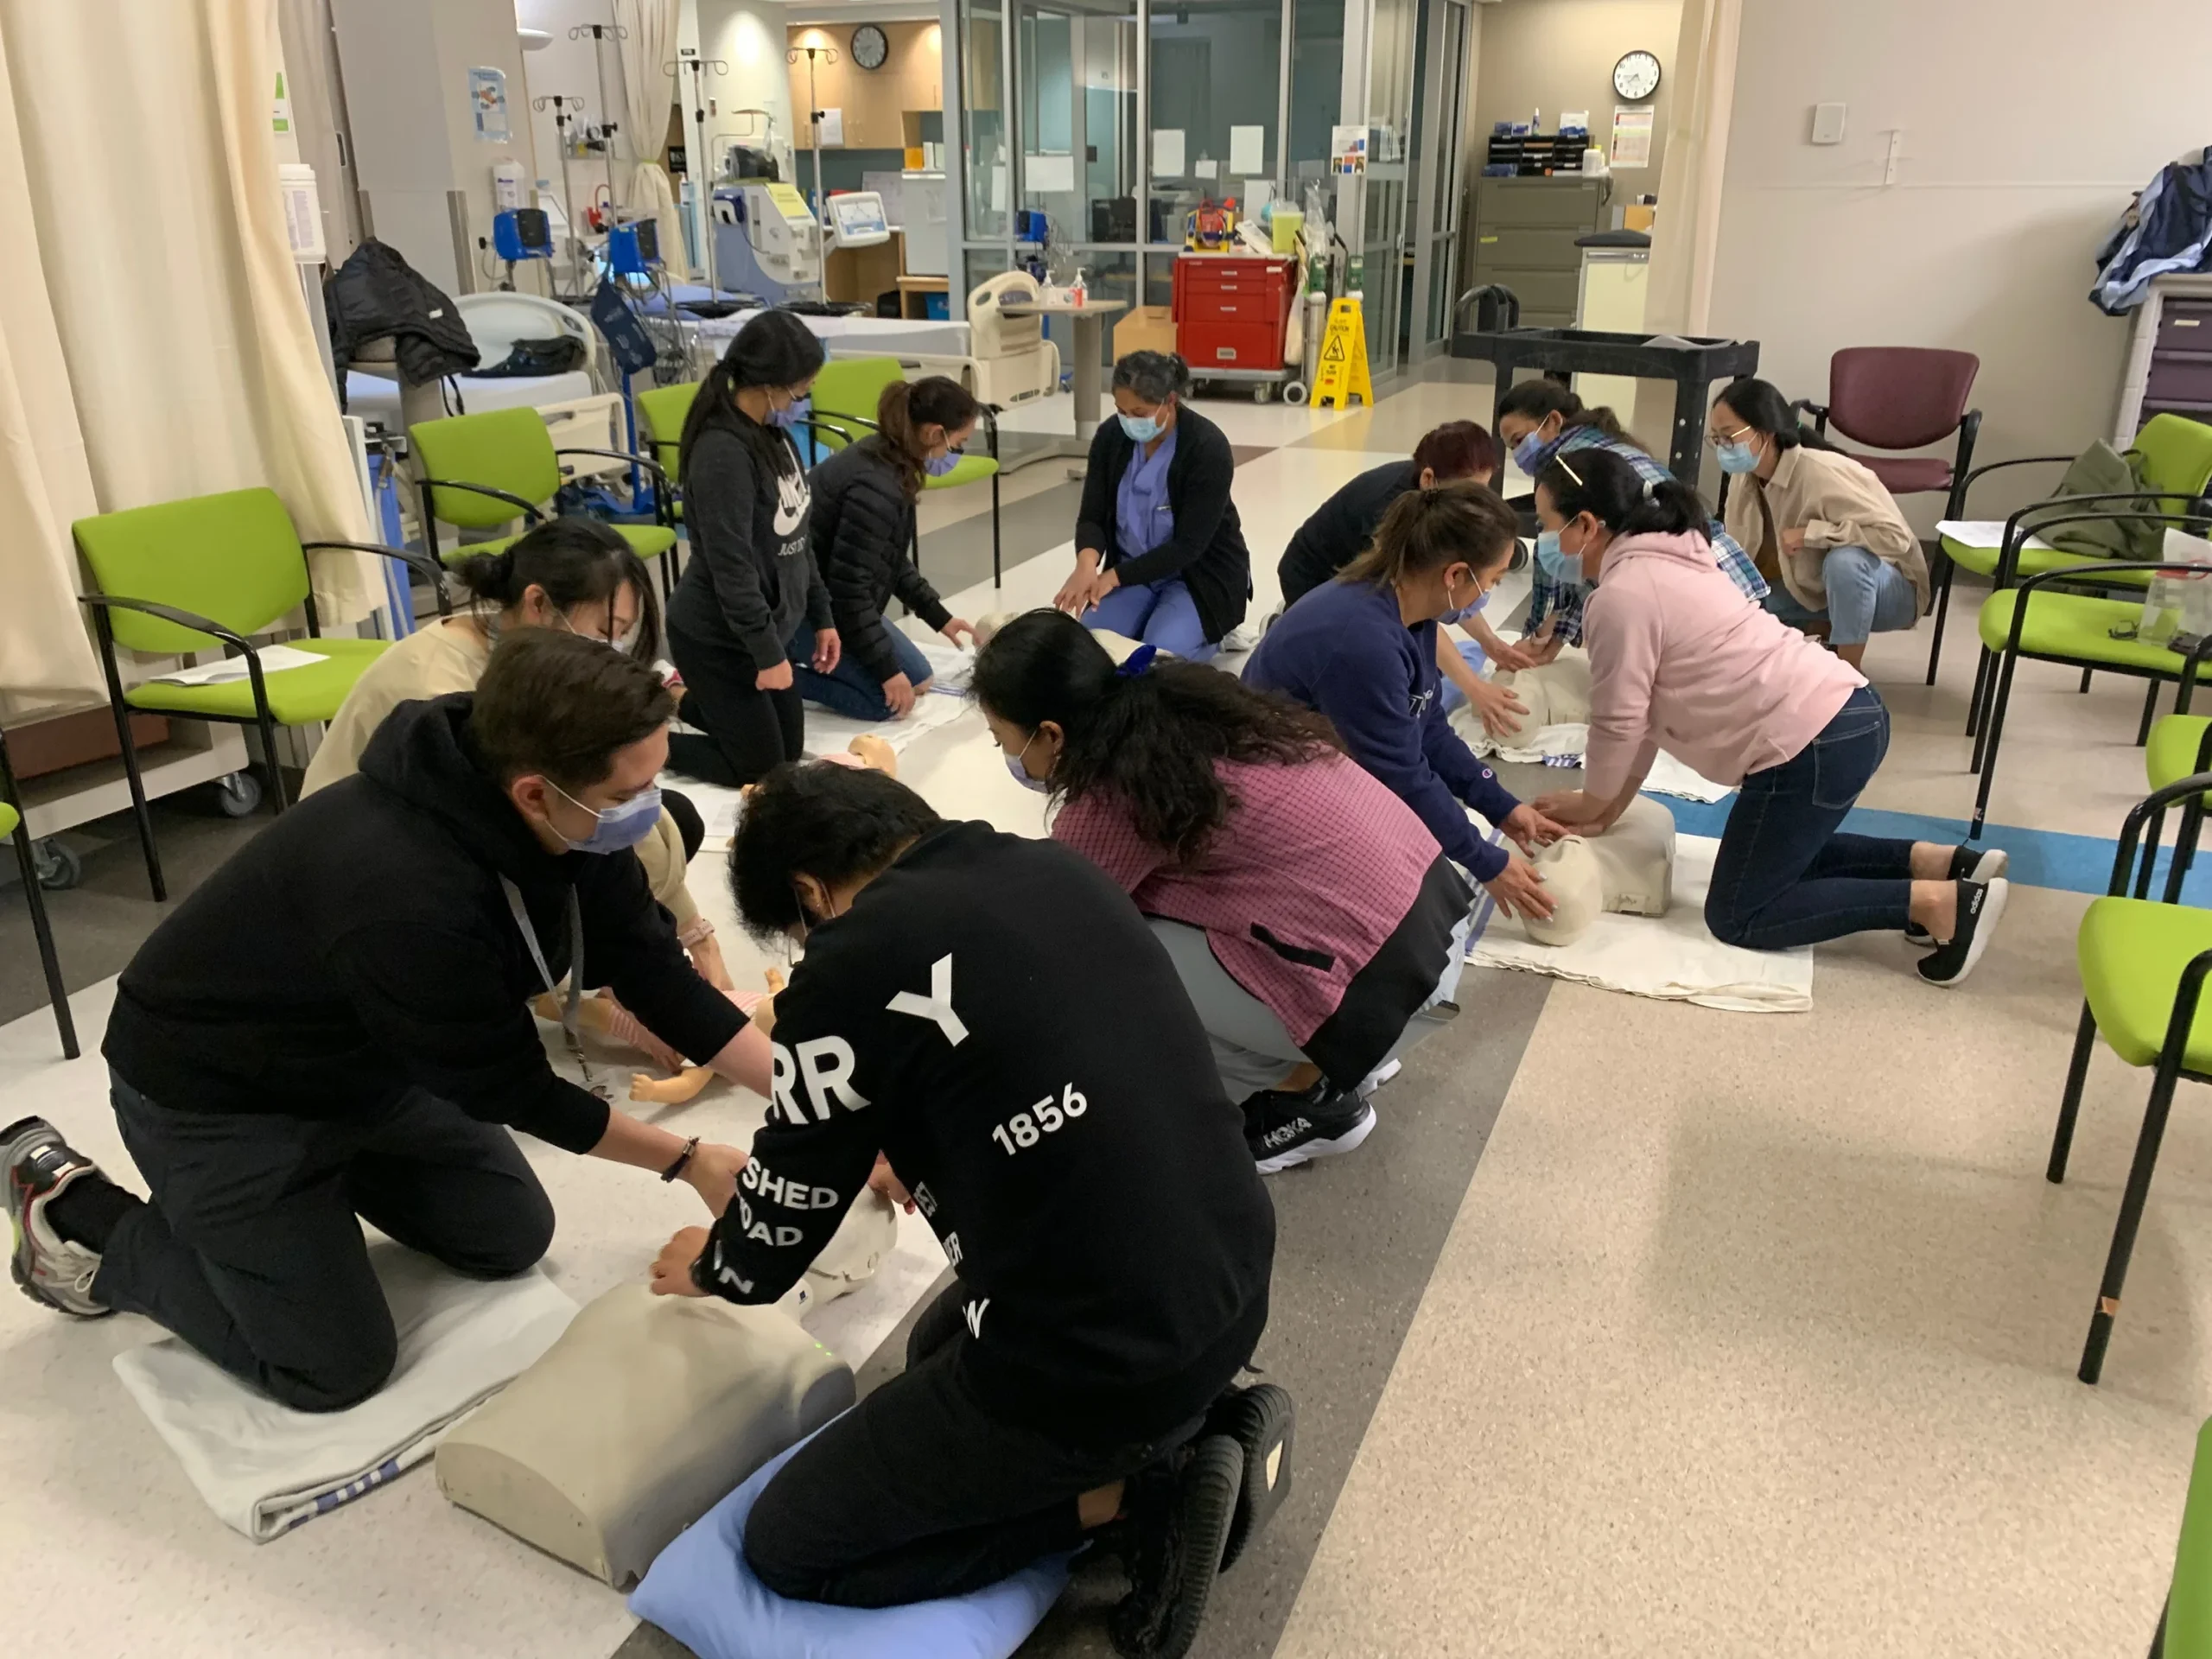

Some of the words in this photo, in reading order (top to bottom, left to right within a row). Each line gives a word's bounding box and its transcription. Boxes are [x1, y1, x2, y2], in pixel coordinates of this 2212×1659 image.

[1970, 888, 1984, 915] adidas
[991, 1082, 1088, 1156] 1856
[1262, 1116, 1313, 1148] HOKA
[741, 1156, 840, 1211] SHED
